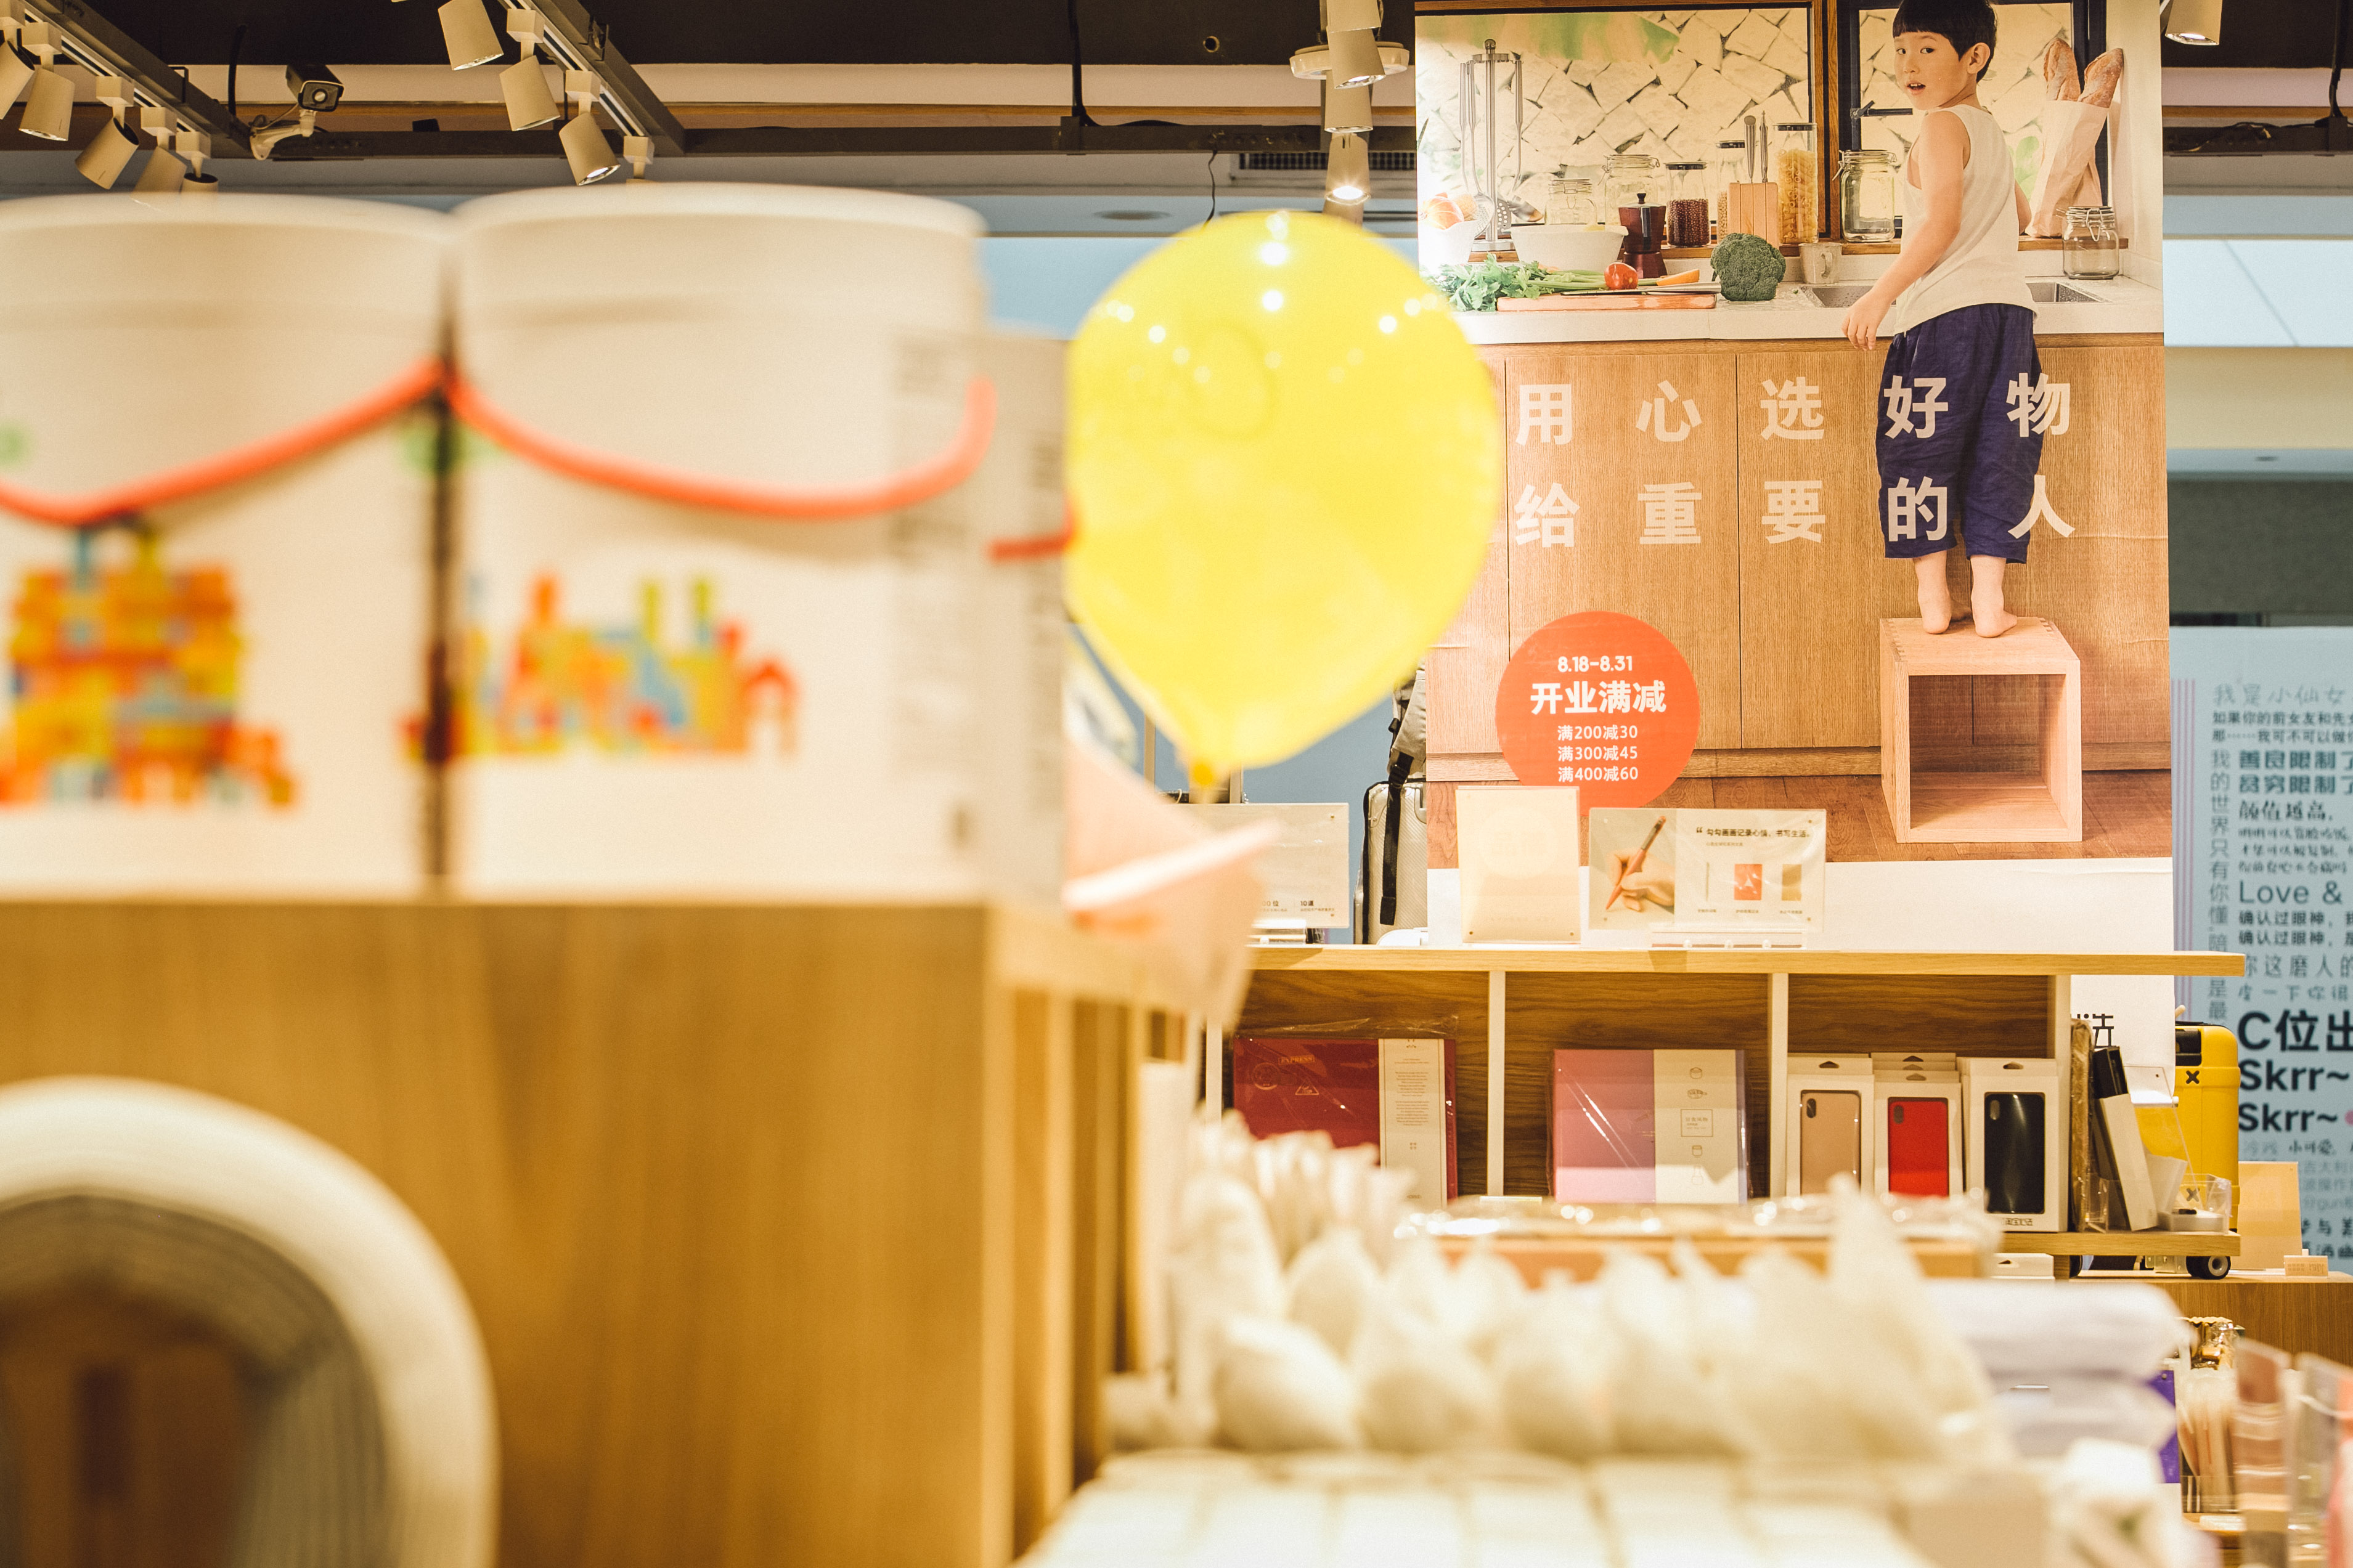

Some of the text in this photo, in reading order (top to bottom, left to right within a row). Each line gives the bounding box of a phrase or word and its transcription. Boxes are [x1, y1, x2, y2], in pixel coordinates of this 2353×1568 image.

[1517, 372, 2071, 446] 用心选好物
[1514, 475, 2076, 548] 给重要的人
[1557, 656, 1633, 672] 8.18-8.31
[1530, 680, 1666, 715] 开业满减
[1557, 725, 1638, 741] 满200减30
[1557, 745, 1638, 762] 满300减45
[1558, 766, 1639, 782] 满400减60
[2239, 880, 2343, 905] Love &
